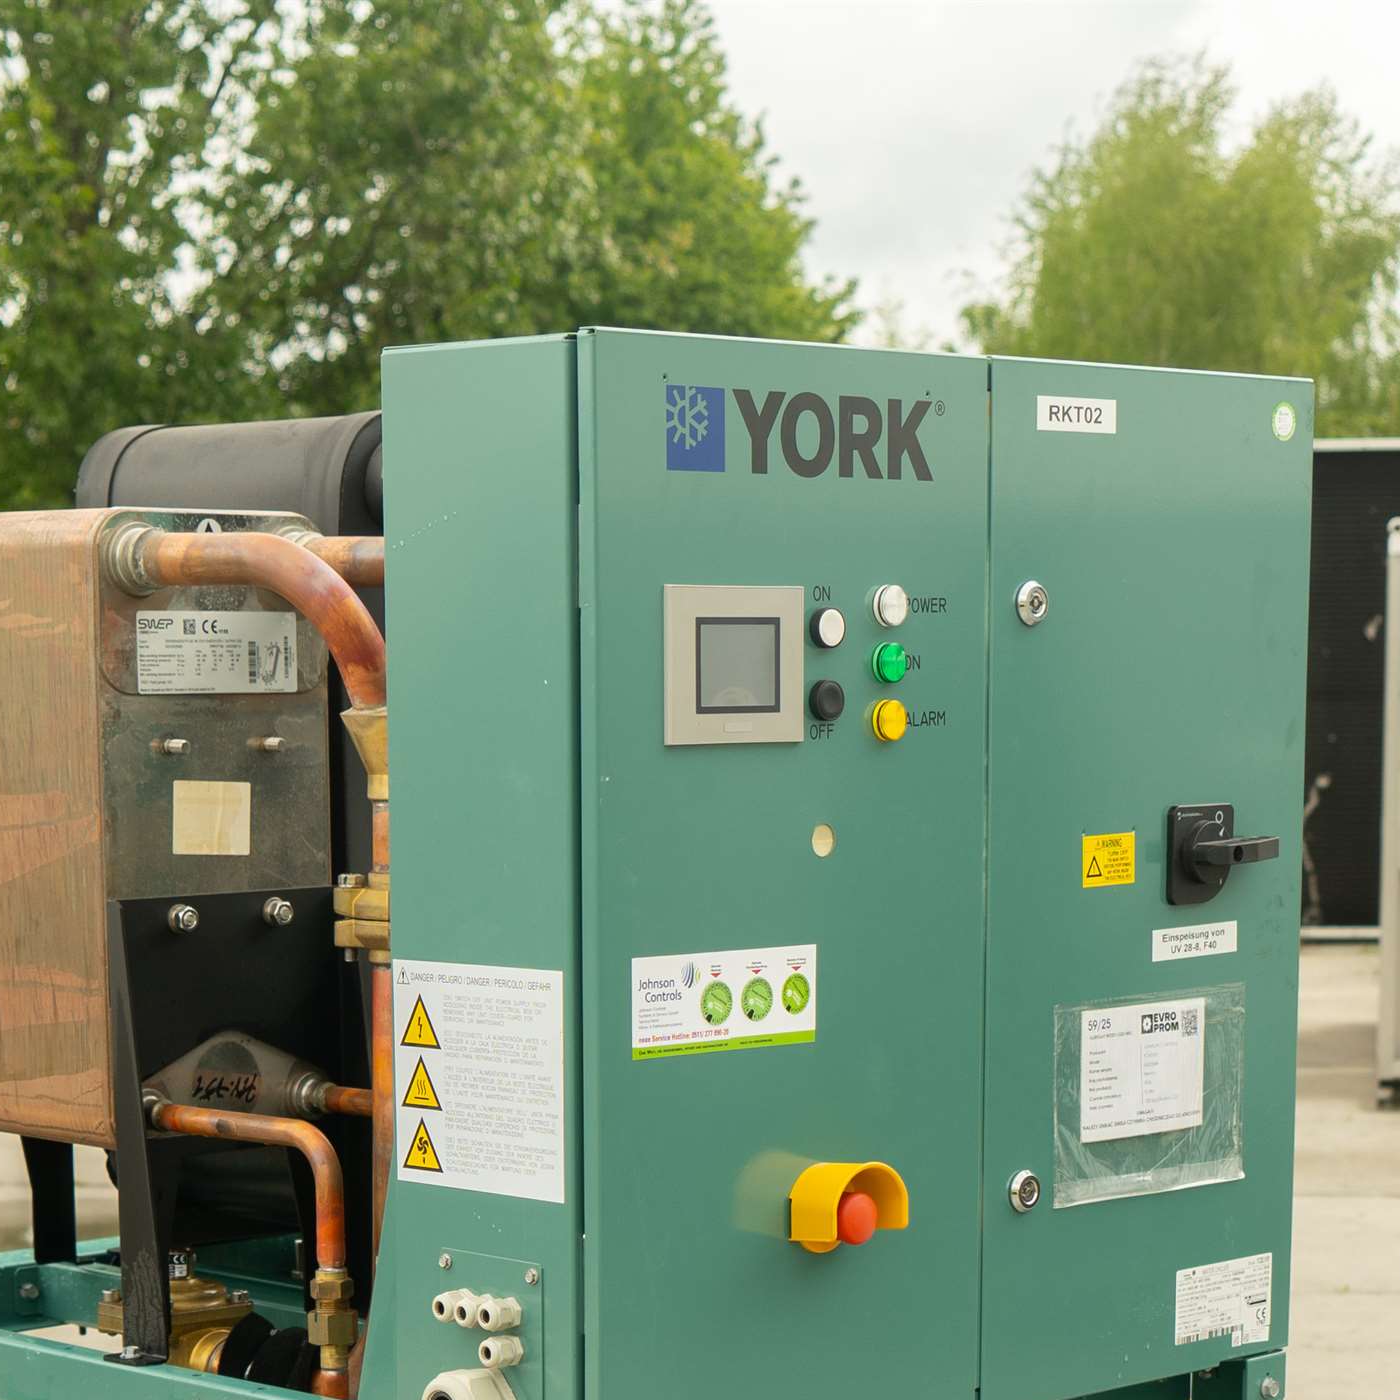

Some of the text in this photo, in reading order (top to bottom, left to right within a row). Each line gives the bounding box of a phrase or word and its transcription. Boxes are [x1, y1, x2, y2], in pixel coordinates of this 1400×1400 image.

[1048, 404, 1103, 425] RKT02
[732, 388, 934, 482] YORK
[812, 585, 831, 602] ON
[138, 618, 174, 630] SWEP
[906, 711, 946, 727] ALARM
[809, 723, 835, 740] OFF
[1161, 928, 1225, 944] Einspeisung von
[1170, 945, 1182, 954] UV
[1203, 940, 1217, 950] F40
[410, 972, 552, 991] DANGER PELIGRO DANGER PERICOLO GEFAHR
[638, 977, 675, 992] Johnson
[644, 989, 682, 1004] Controls
[1088, 1011, 1177, 1032] 59/25 EVRO
[1153, 1021, 1179, 1032] PROM
